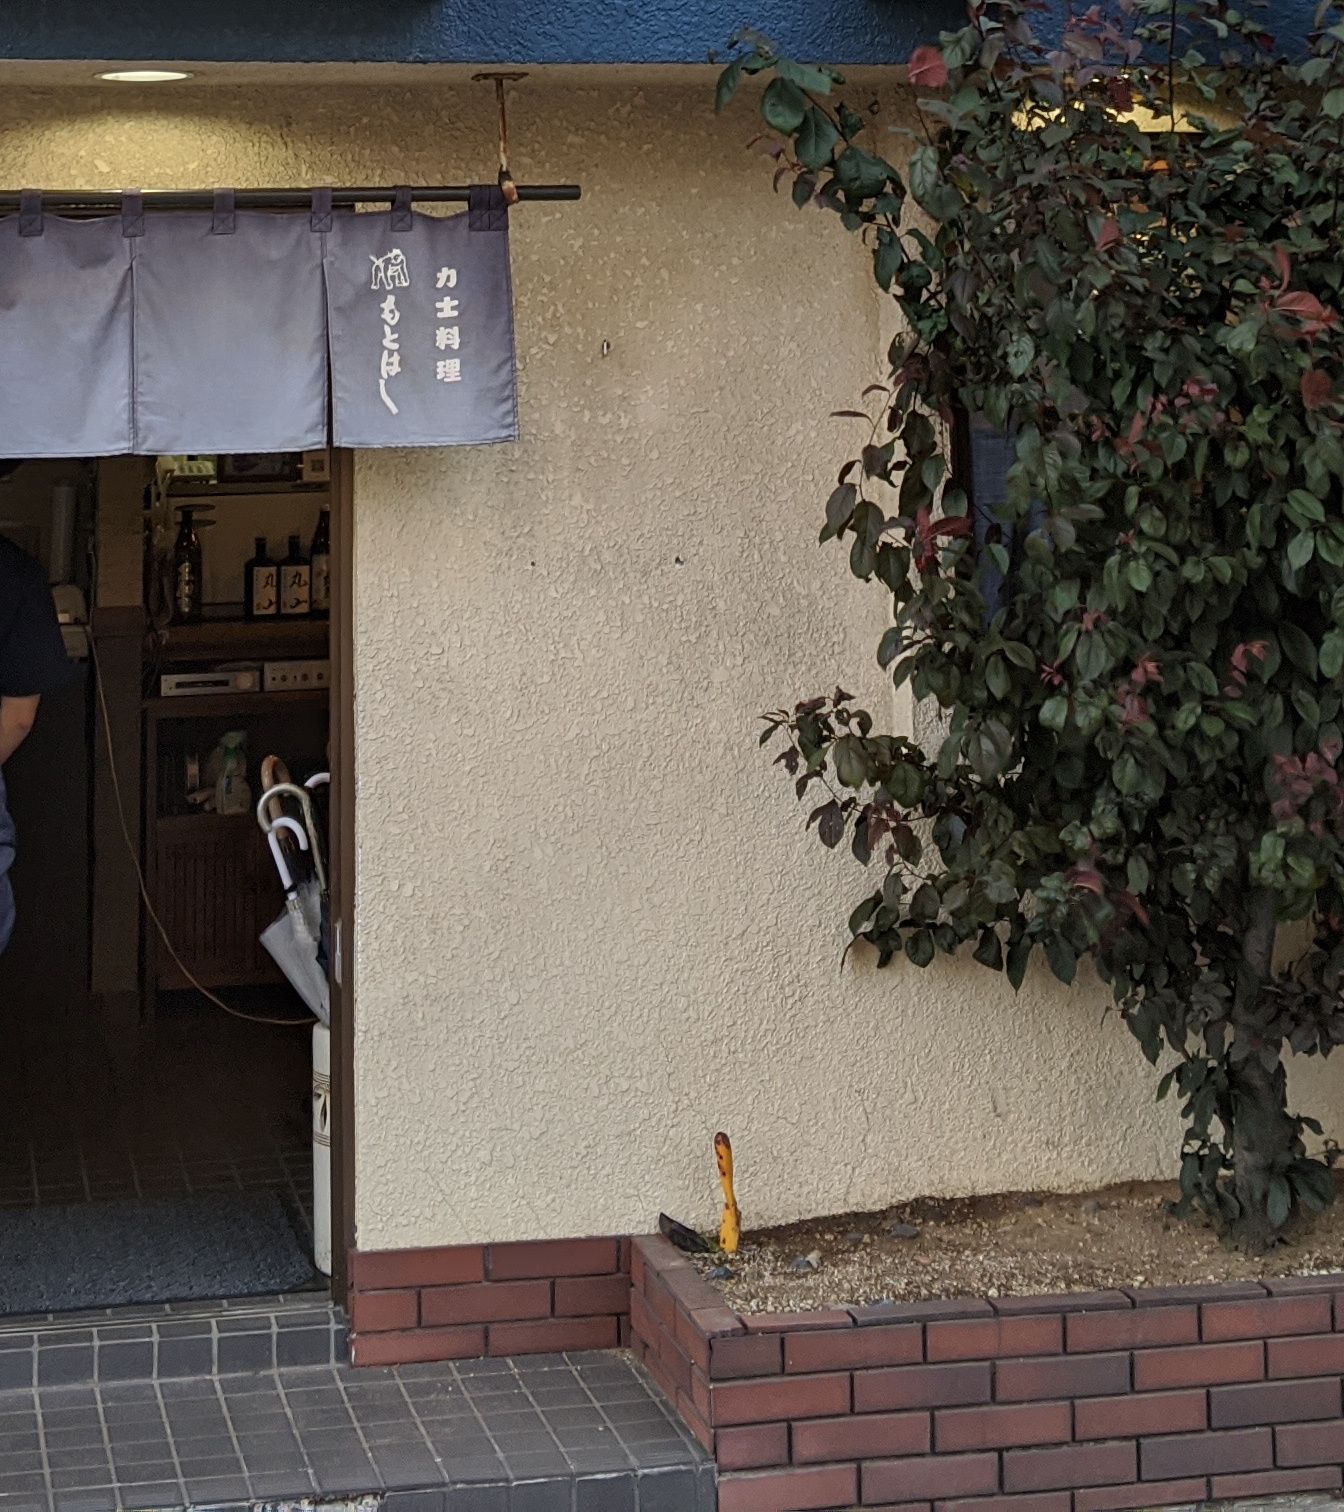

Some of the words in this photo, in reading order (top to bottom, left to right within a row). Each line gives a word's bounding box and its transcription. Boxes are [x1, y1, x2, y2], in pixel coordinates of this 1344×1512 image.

[379, 294, 401, 416] もとはし
[435, 267, 462, 383] 力士料理
